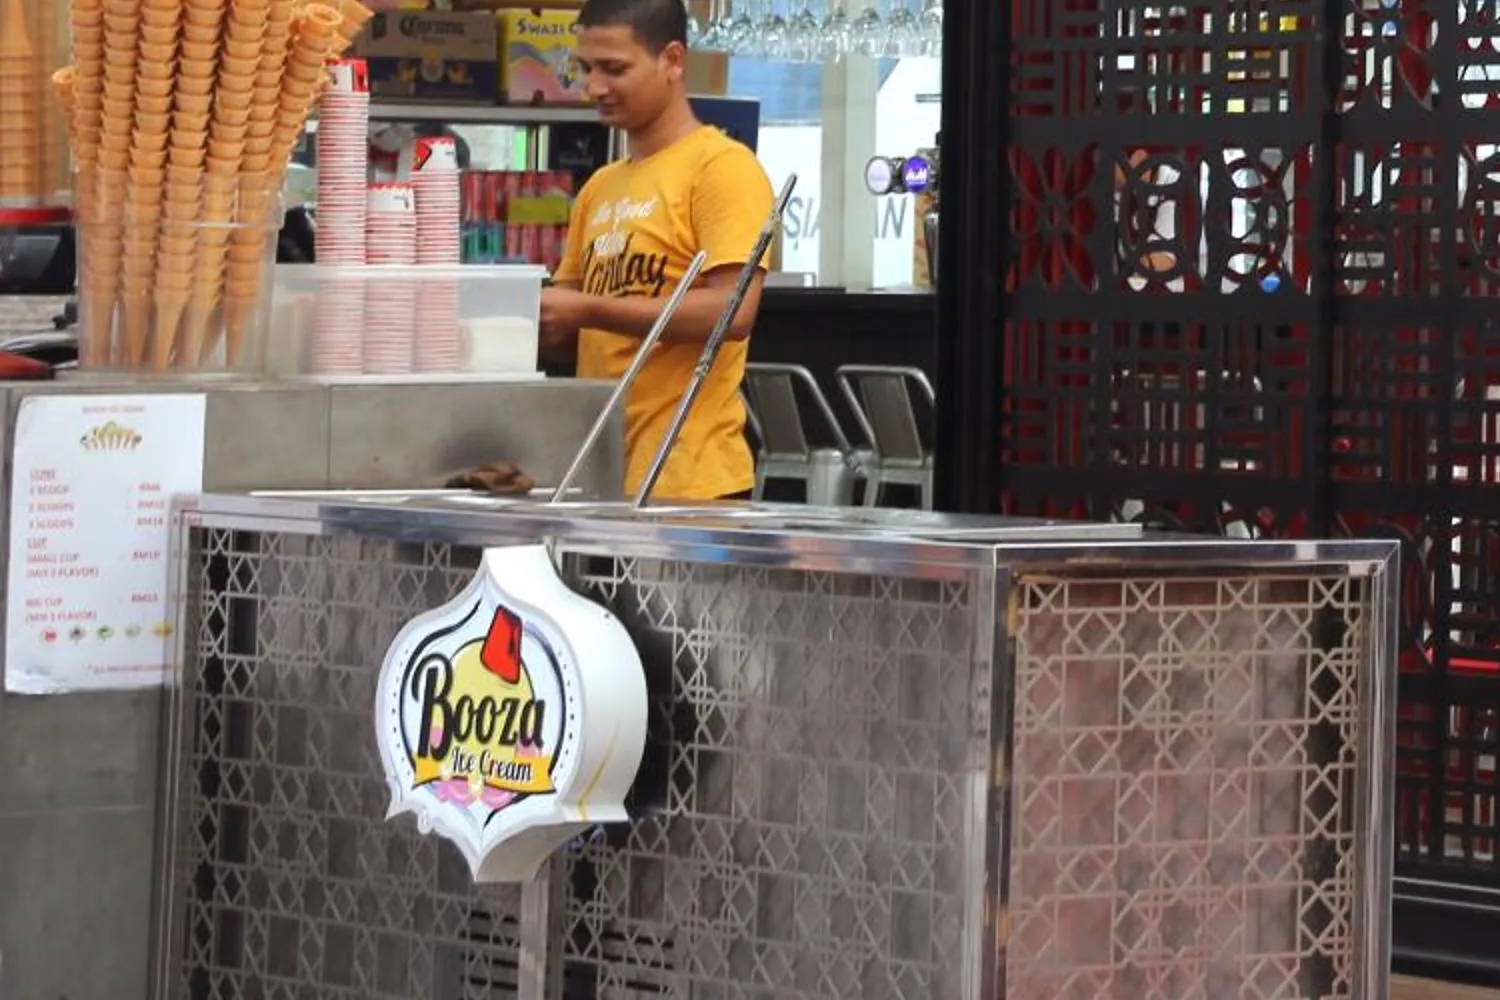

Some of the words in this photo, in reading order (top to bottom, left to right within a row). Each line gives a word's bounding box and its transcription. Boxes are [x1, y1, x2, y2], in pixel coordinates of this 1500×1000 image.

[411, 653, 546, 761] Booza
[452, 746, 476, 774] Ice
[479, 749, 532, 782] Cream
